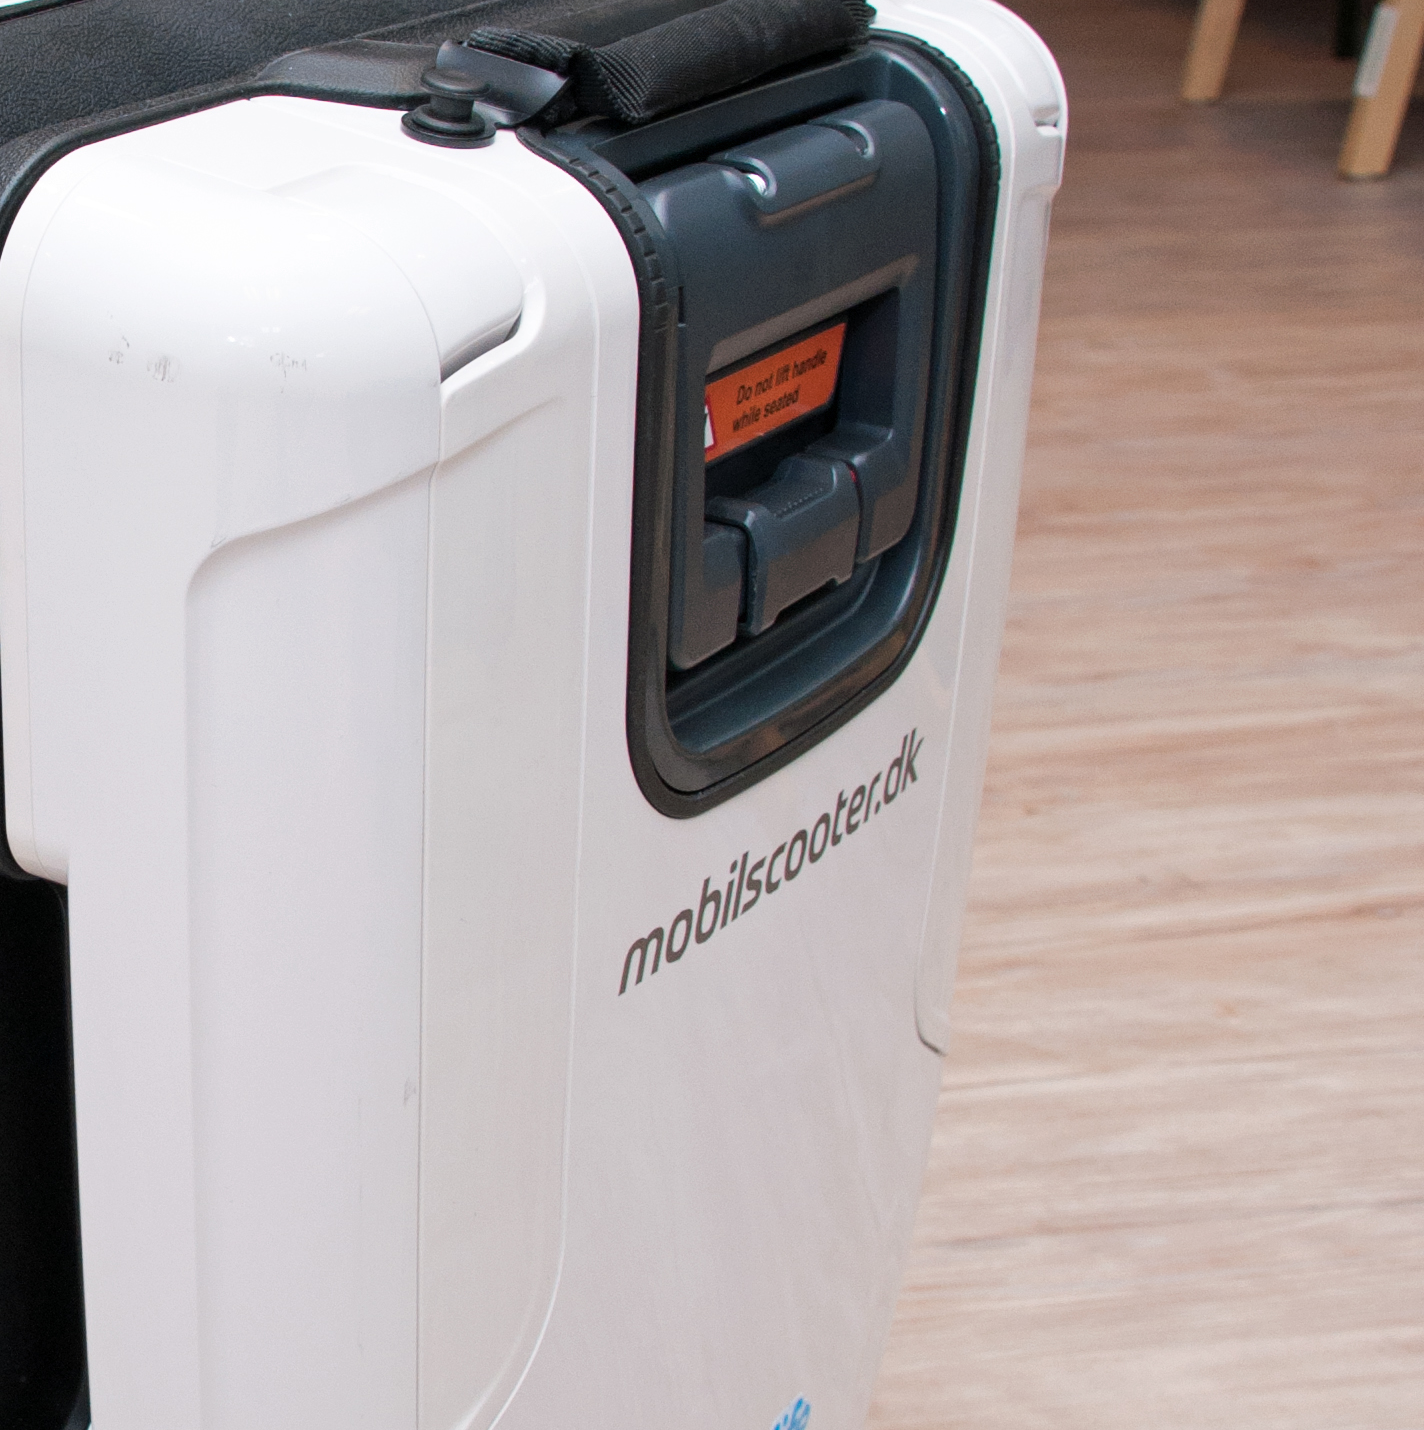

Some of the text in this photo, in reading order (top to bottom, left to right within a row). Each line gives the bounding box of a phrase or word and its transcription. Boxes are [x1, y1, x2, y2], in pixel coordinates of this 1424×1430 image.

[737, 349, 828, 406] Do not lift handle
[732, 385, 801, 433] while seated
[617, 728, 924, 997] mobilscooter.dk
